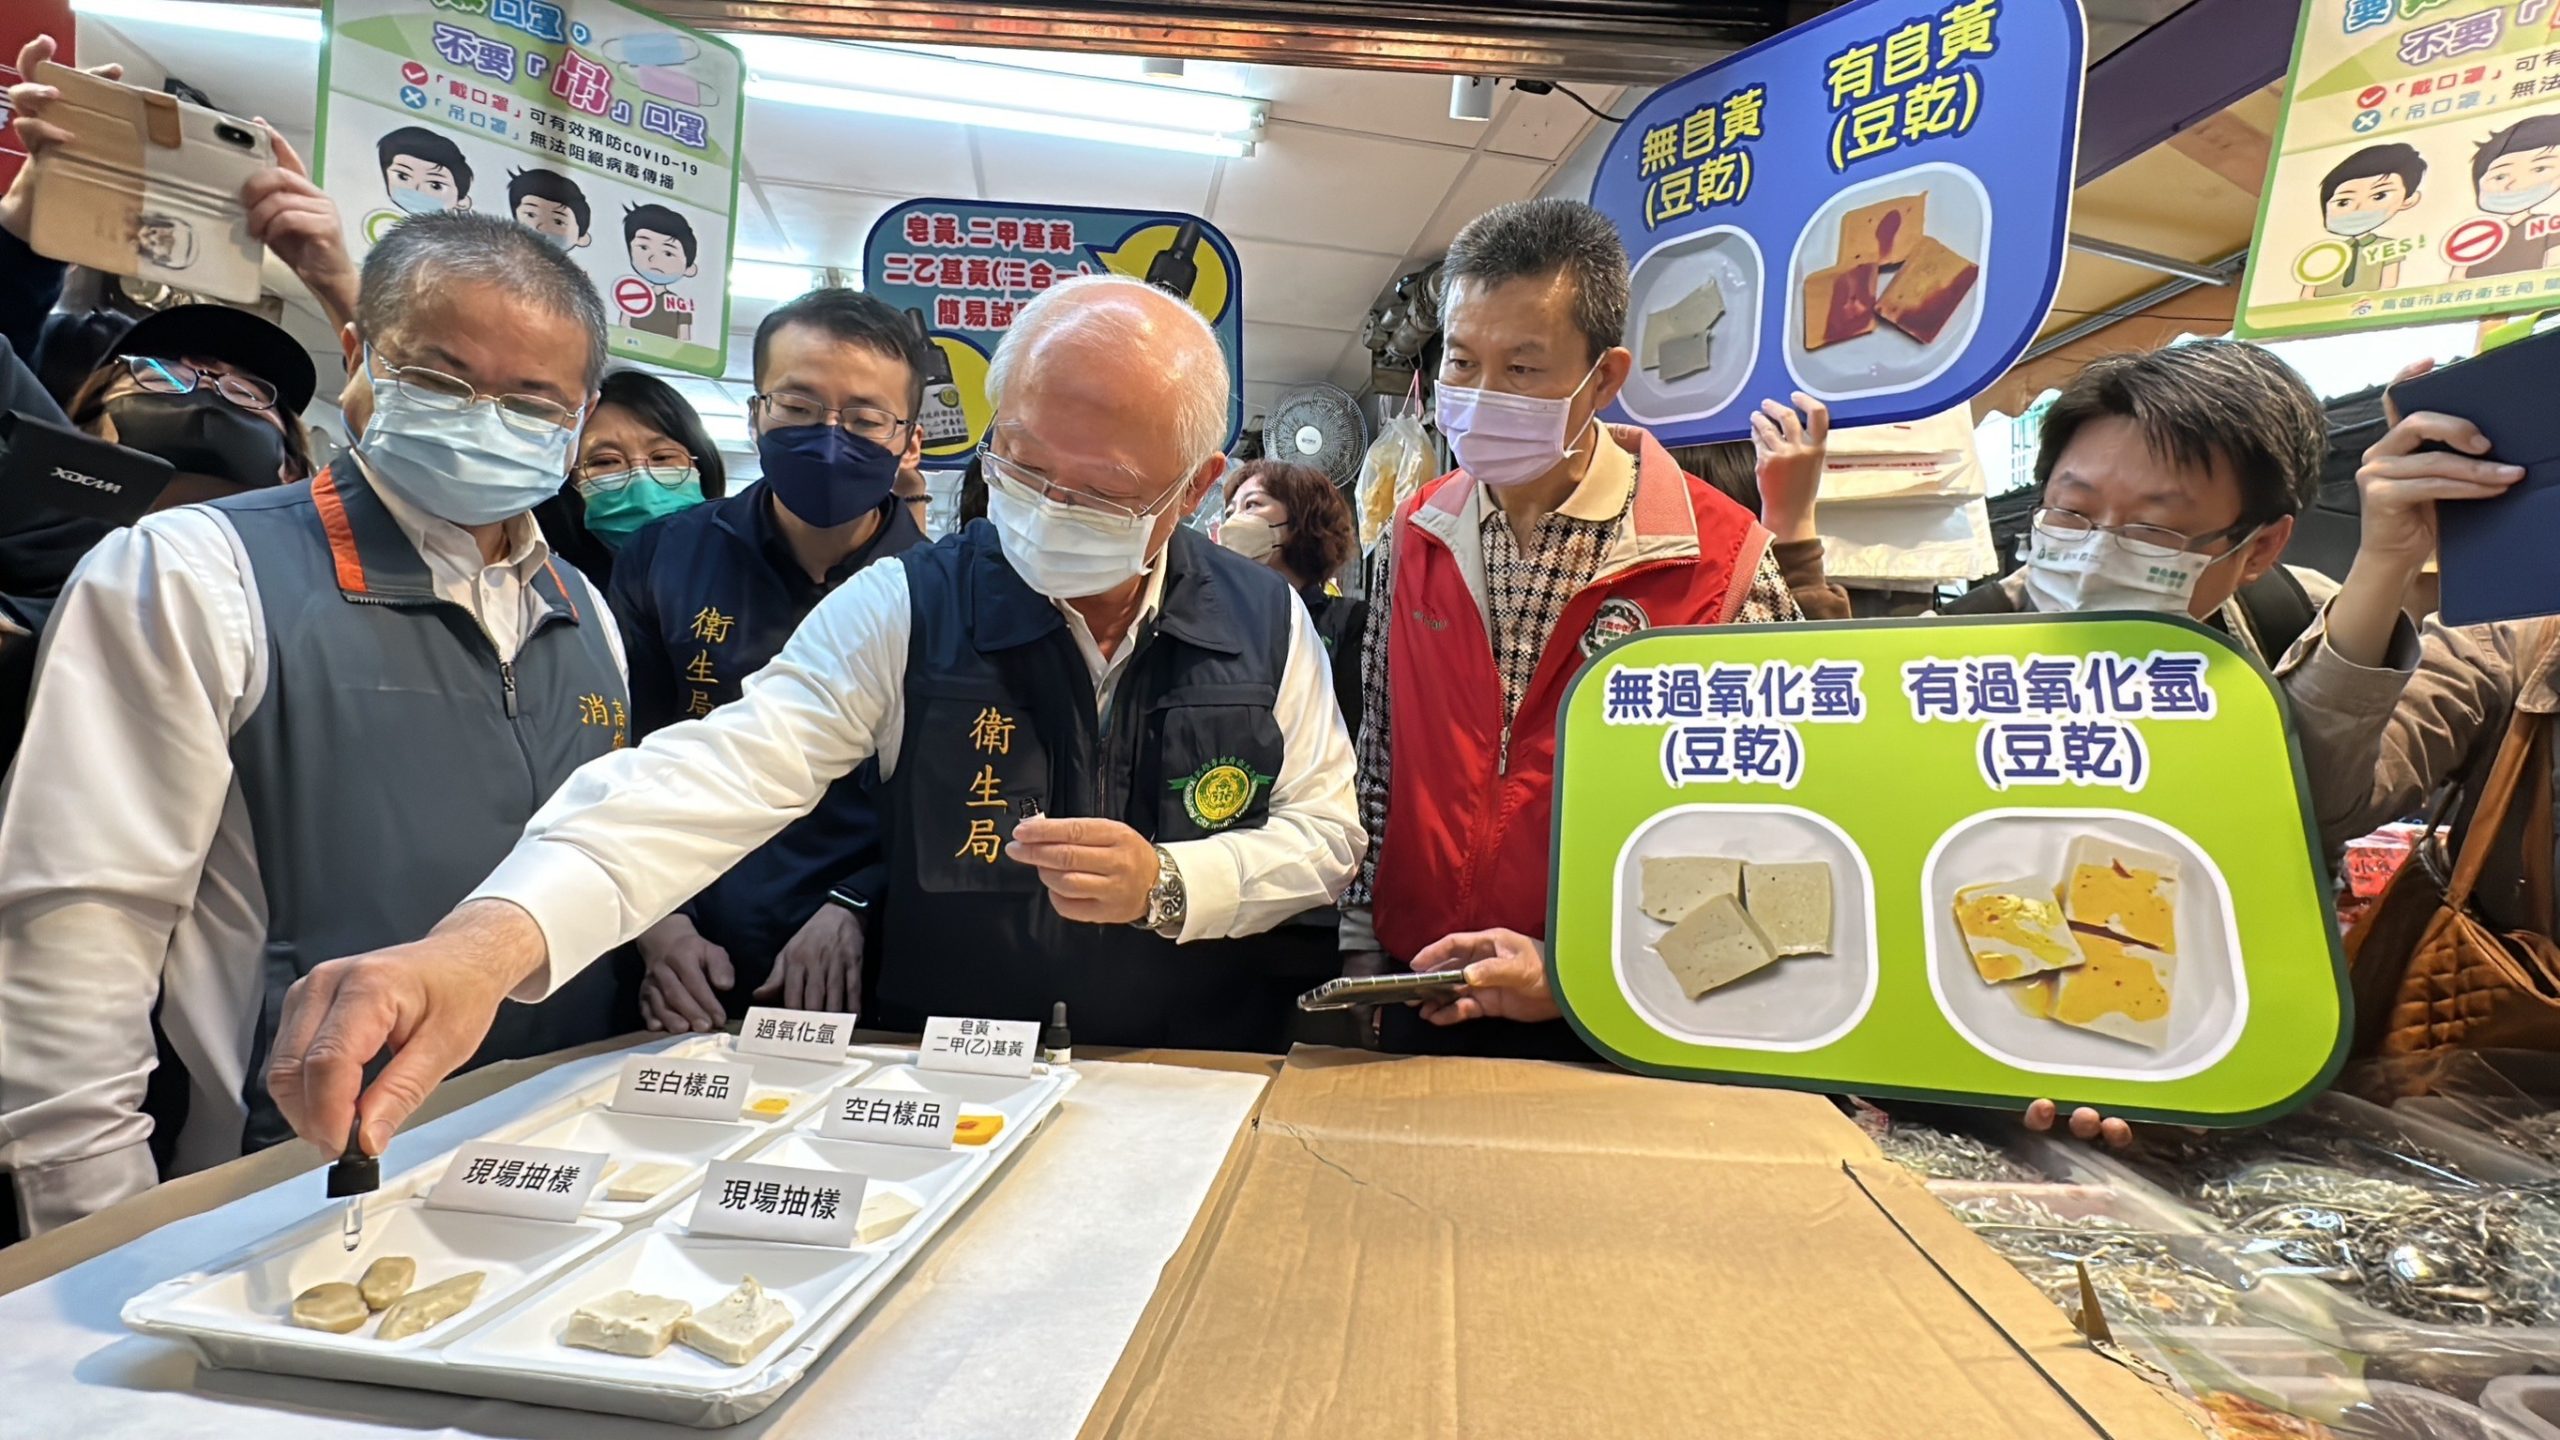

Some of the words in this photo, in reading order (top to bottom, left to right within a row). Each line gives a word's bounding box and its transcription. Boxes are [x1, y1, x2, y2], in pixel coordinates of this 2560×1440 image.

[1831, 71, 1979, 170] (豆乾)
[1645, 150, 1751, 229] (豆乾)
[2366, 235, 2426, 263] YES!
[936, 299, 1030, 327] 簡易試
[51, 466, 122, 494] XDCAM
[686, 605, 736, 713] 衛生局
[1608, 665, 1860, 719] 無過氧化氫
[1907, 657, 2209, 716] 有過氧化氫
[579, 693, 610, 727] 消
[1665, 724, 1799, 783] (豆乾)
[1983, 721, 2142, 785] (豆乾)
[955, 706, 1017, 865] 衛生局
[756, 1017, 837, 1046] 過氧化氫
[932, 1036, 1024, 1057] 二甲(乙)基黃
[634, 1067, 730, 1100] 空白樣品
[841, 1097, 941, 1129] 空白樣品
[461, 1156, 581, 1194] 現場抽樣
[718, 1179, 842, 1220] 現場抽樣
